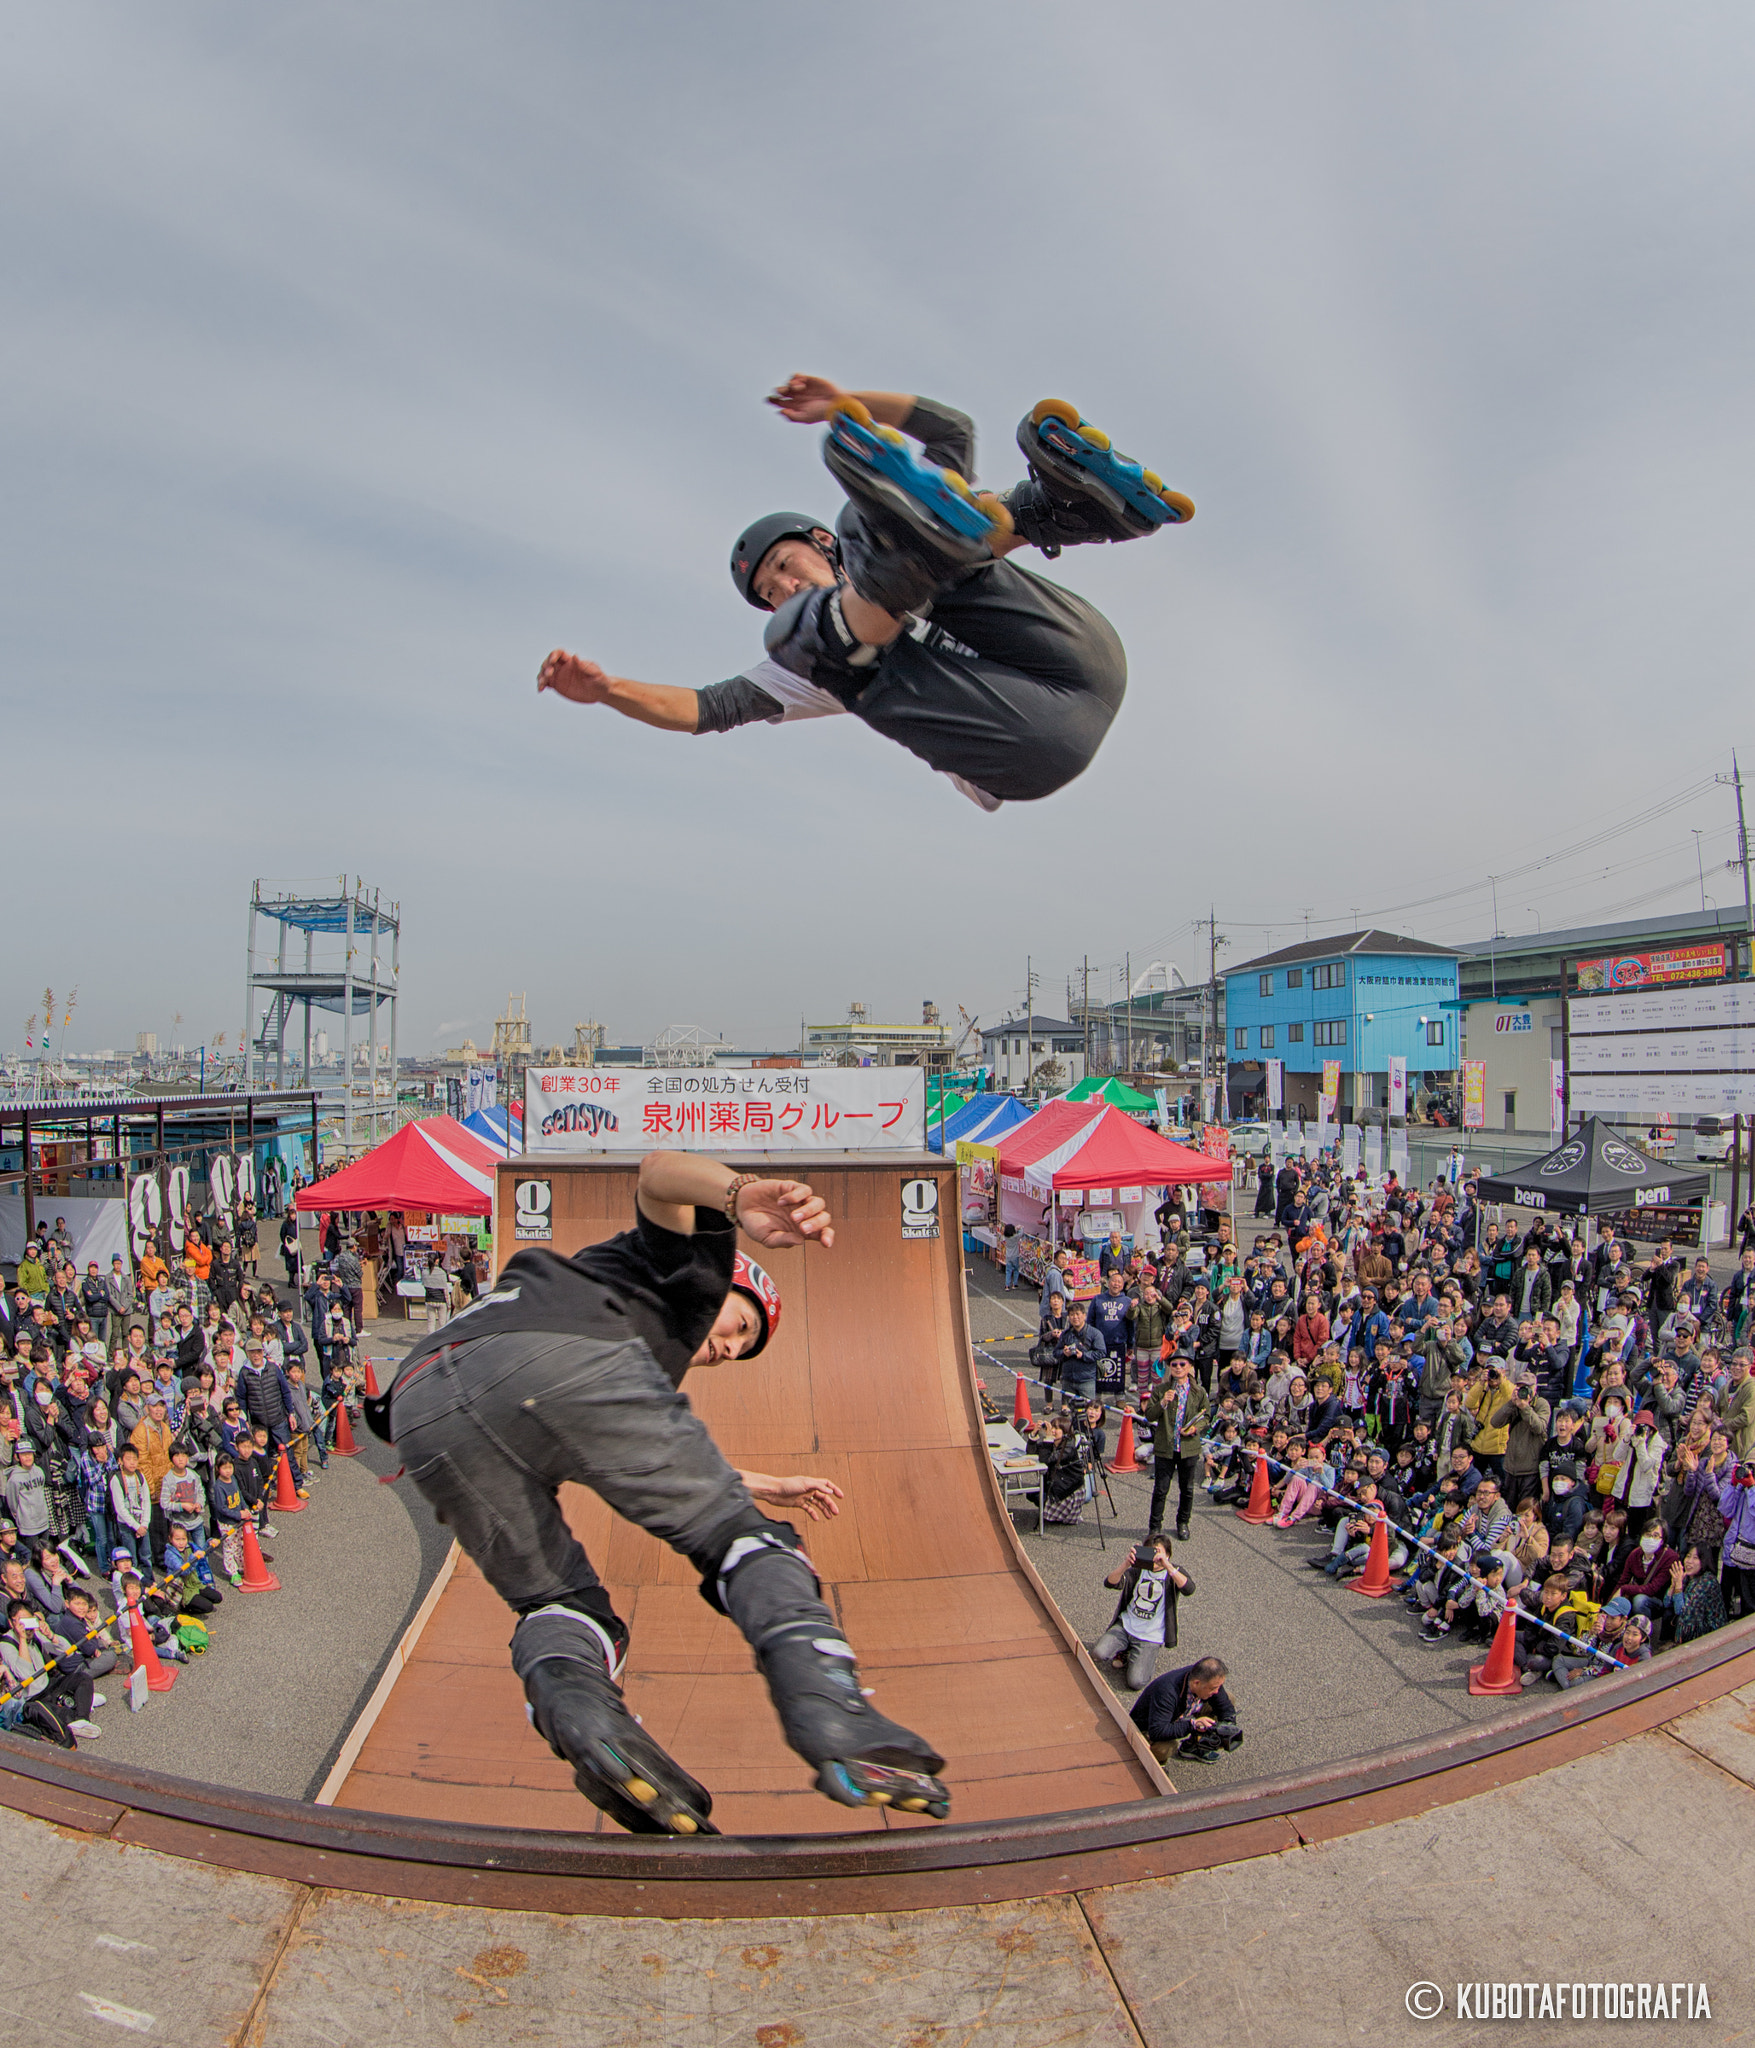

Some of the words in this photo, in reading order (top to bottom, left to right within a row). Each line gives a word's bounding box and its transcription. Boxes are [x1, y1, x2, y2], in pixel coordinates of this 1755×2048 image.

[1652, 973, 1665, 981] TEL
[541, 1075, 621, 1093] 創業30年
[646, 1076, 811, 1094] 全国の処方せん受付
[542, 1103, 619, 1137] sensyu
[642, 1098, 908, 1133] 泉州薬局グループ
[1514, 1186, 1546, 1208] bern
[1635, 1185, 1670, 1206] bern
[516, 1228, 551, 1239] skates
[902, 1227, 939, 1238] skates
[1102, 1301, 1124, 1311] POLO
